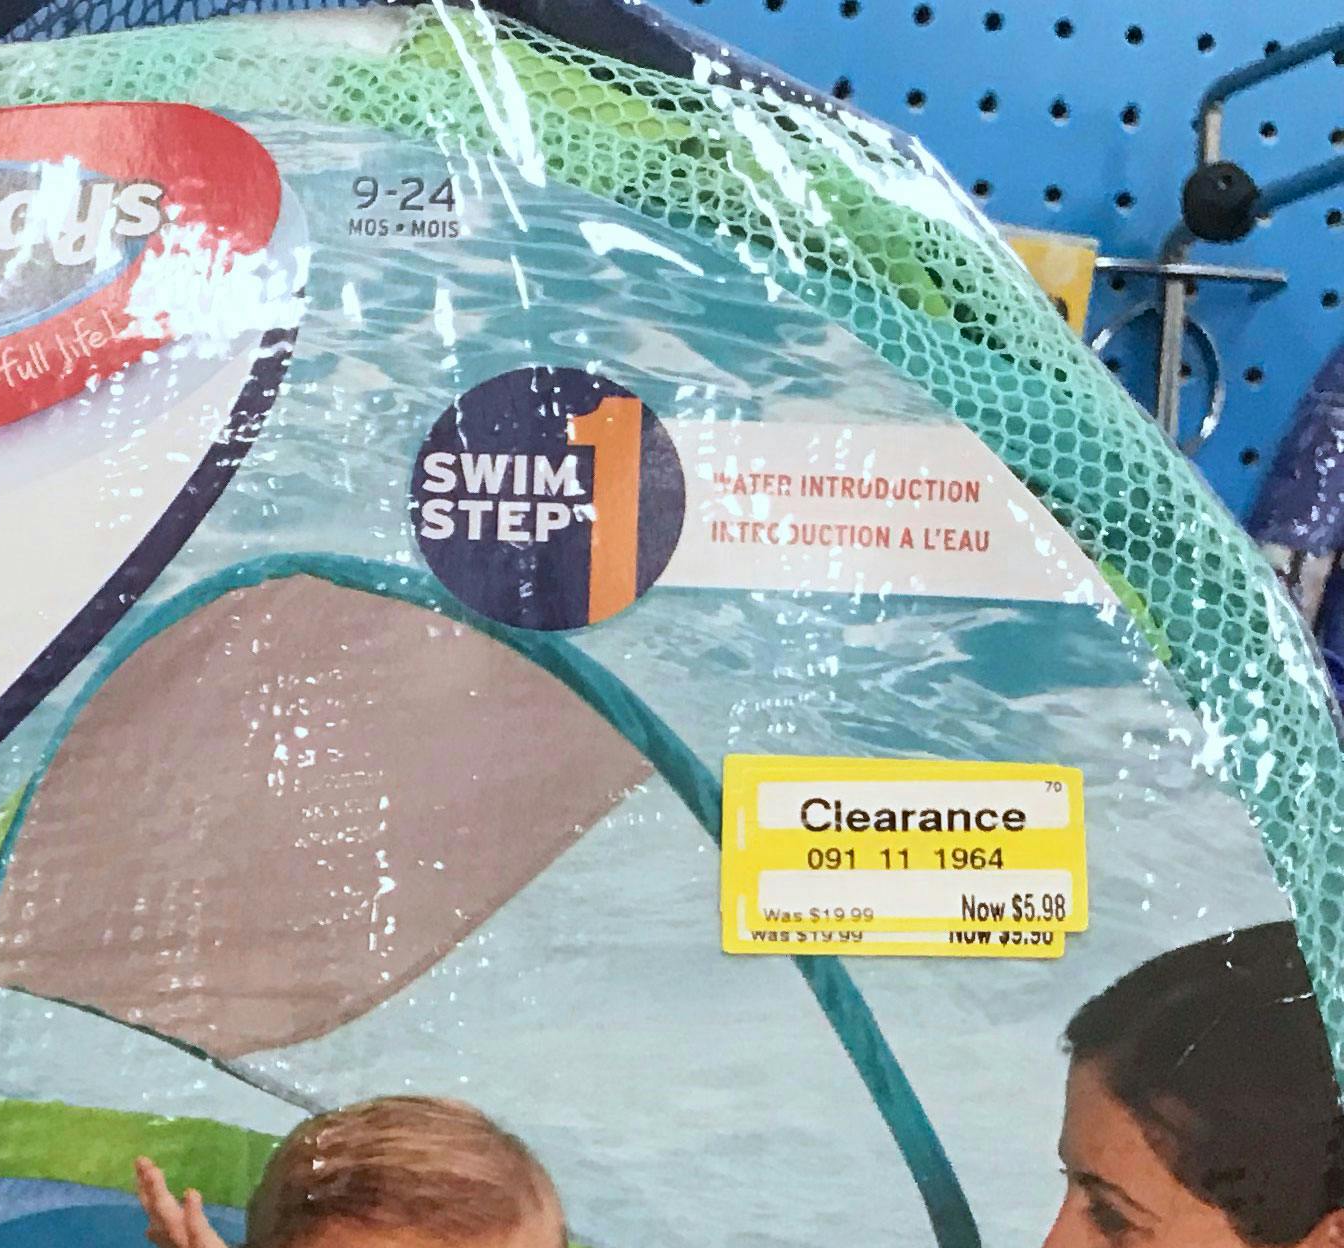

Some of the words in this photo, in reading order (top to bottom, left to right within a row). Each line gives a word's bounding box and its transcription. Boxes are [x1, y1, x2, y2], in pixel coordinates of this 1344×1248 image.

[352, 176, 456, 212] 9-24
[349, 219, 389, 237] MOS
[412, 219, 459, 238] MOIS
[422, 452, 586, 497] SWIM
[898, 529, 914, 550] A
[923, 529, 990, 553] L'EAU
[1044, 781, 1062, 793] 70
[800, 798, 1026, 833] Clearance
[807, 848, 856, 870] 091
[880, 848, 910, 870] 11
[934, 848, 1004, 870] 1964
[763, 908, 803, 923] Was
[961, 893, 1006, 922] Now
[1011, 894, 1066, 922] $5.98
